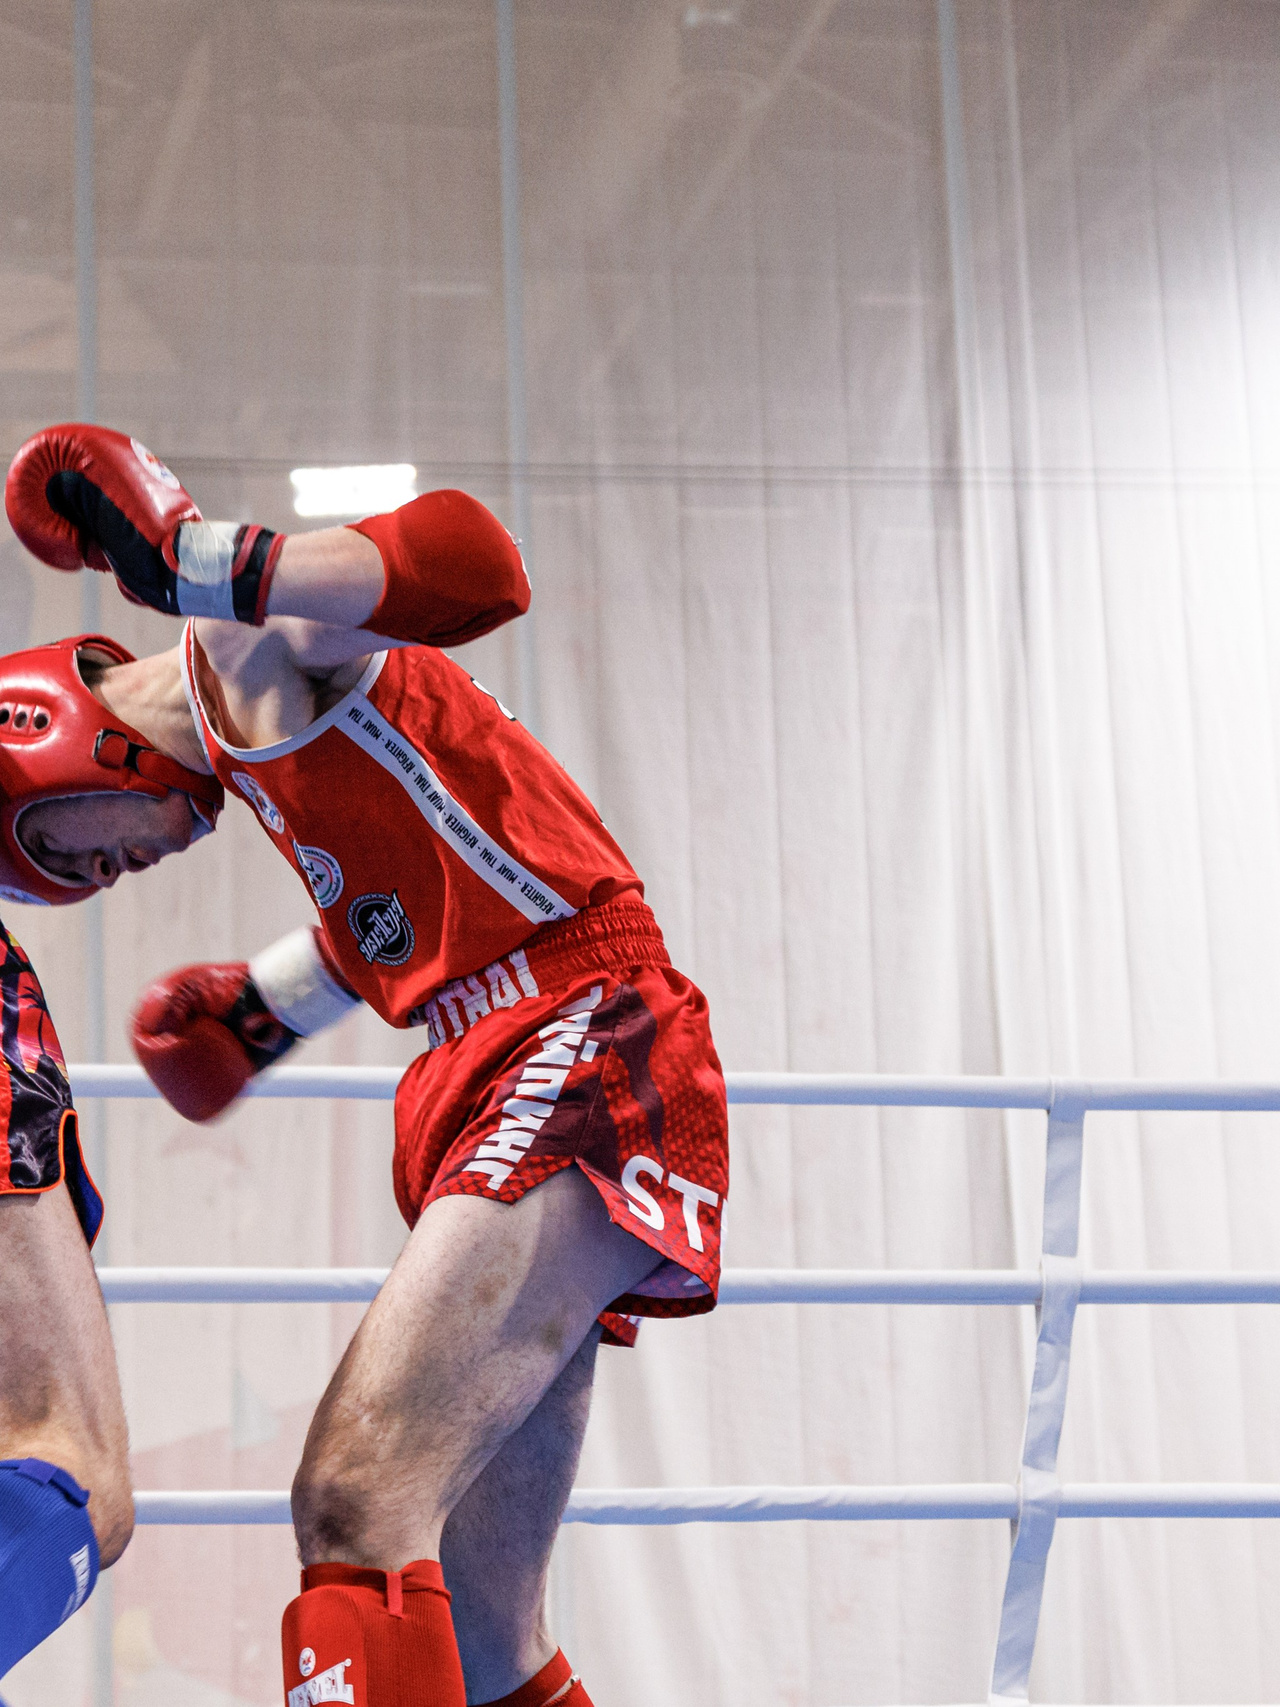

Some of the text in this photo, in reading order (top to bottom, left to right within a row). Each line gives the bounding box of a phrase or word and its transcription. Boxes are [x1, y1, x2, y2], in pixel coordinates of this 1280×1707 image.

[345, 705, 366, 724] THA
[360, 718, 383, 740] MUAY
[382, 738, 415, 774] RFIGHTER
[412, 772, 431, 793] THAI
[425, 789, 446, 813] MUAY
[443, 812, 479, 849] RFIGHTER
[477, 846, 499, 868] THAI
[495, 862, 519, 884] MUAY
[517, 880, 556, 914] RFIGHTER
[621, 1154, 728, 1262] ST
